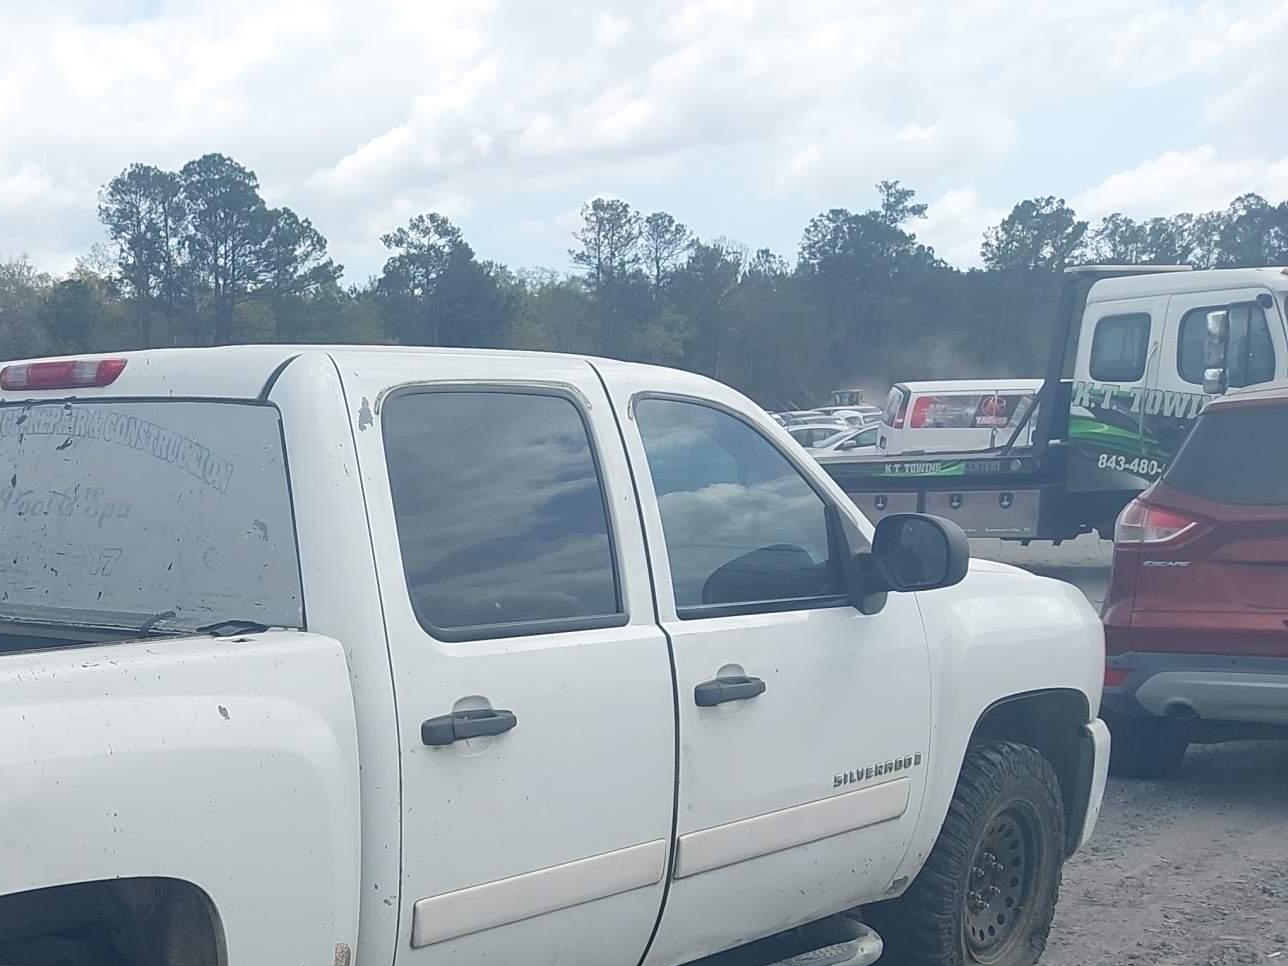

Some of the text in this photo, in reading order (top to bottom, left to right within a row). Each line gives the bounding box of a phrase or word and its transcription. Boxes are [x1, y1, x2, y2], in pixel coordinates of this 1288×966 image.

[904, 462, 941, 473] TOWING
[1098, 454, 1166, 475] 843-480-
[833, 755, 913, 788] SILVERADO
